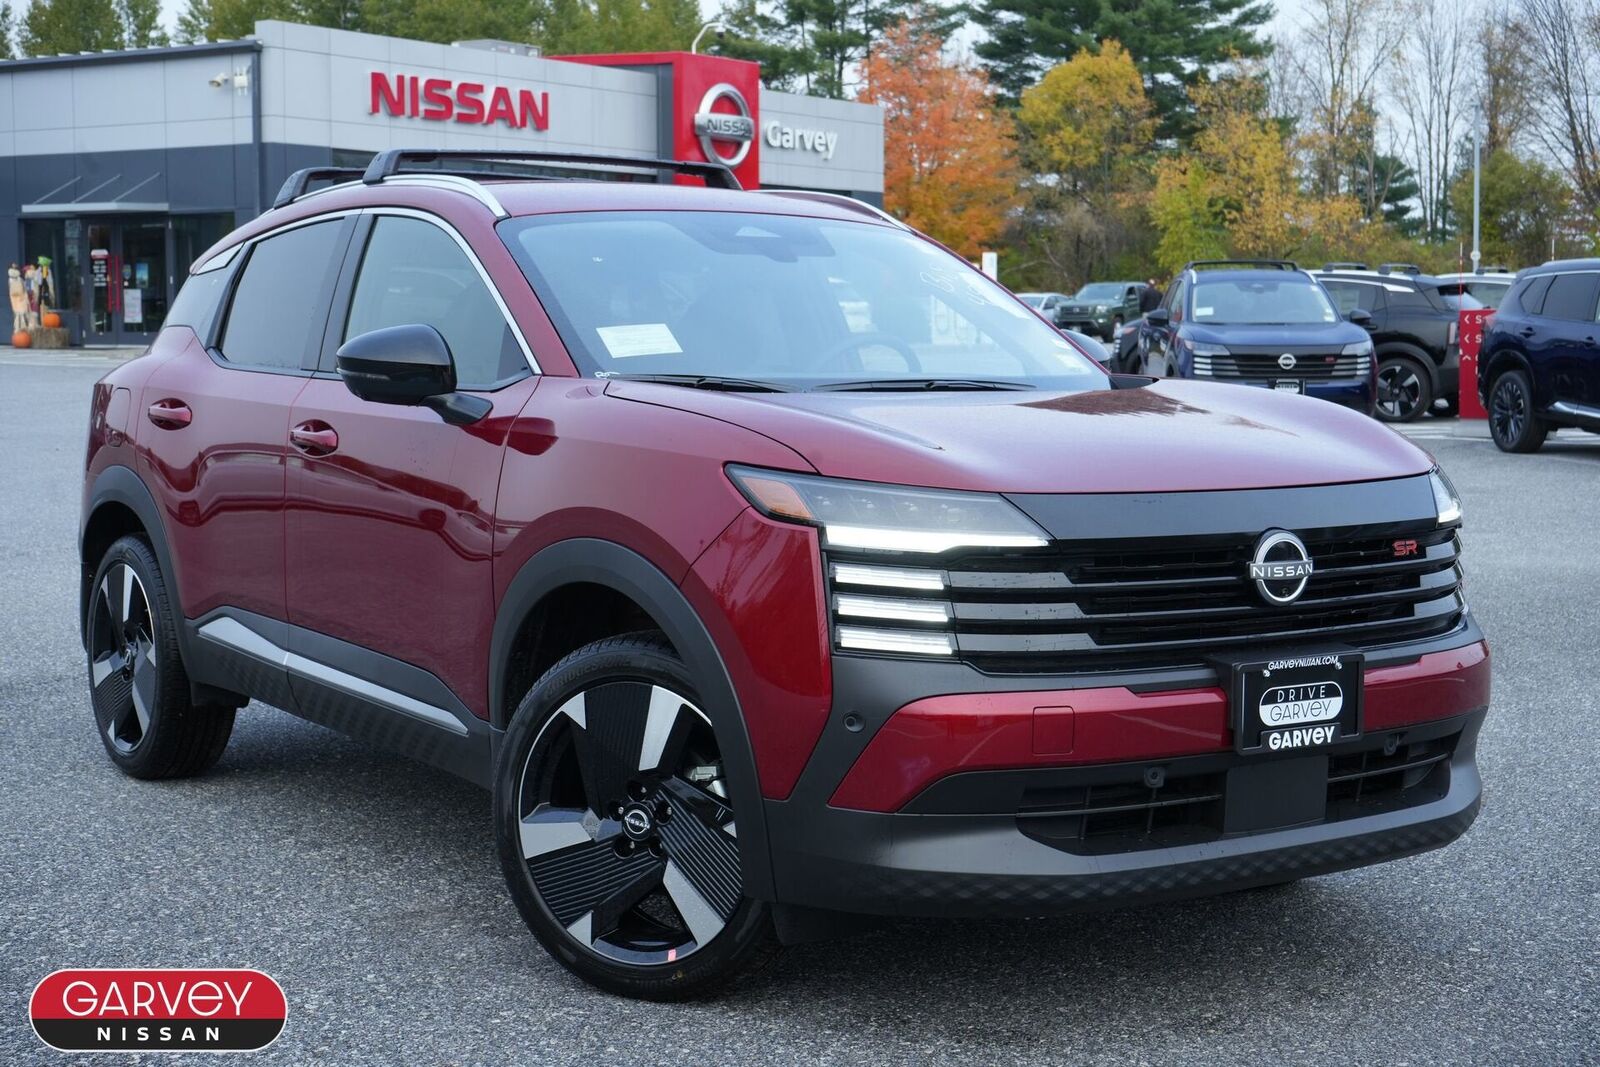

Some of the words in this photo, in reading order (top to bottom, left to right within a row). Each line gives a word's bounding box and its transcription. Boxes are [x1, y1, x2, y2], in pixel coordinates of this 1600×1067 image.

[369, 71, 550, 131] NISSAN
[706, 119, 752, 136] NISSAN
[766, 120, 838, 160] Garvey
[1393, 540, 1418, 556] SR
[1252, 564, 1313, 578] NISSAN
[1277, 685, 1327, 703] DRIVE
